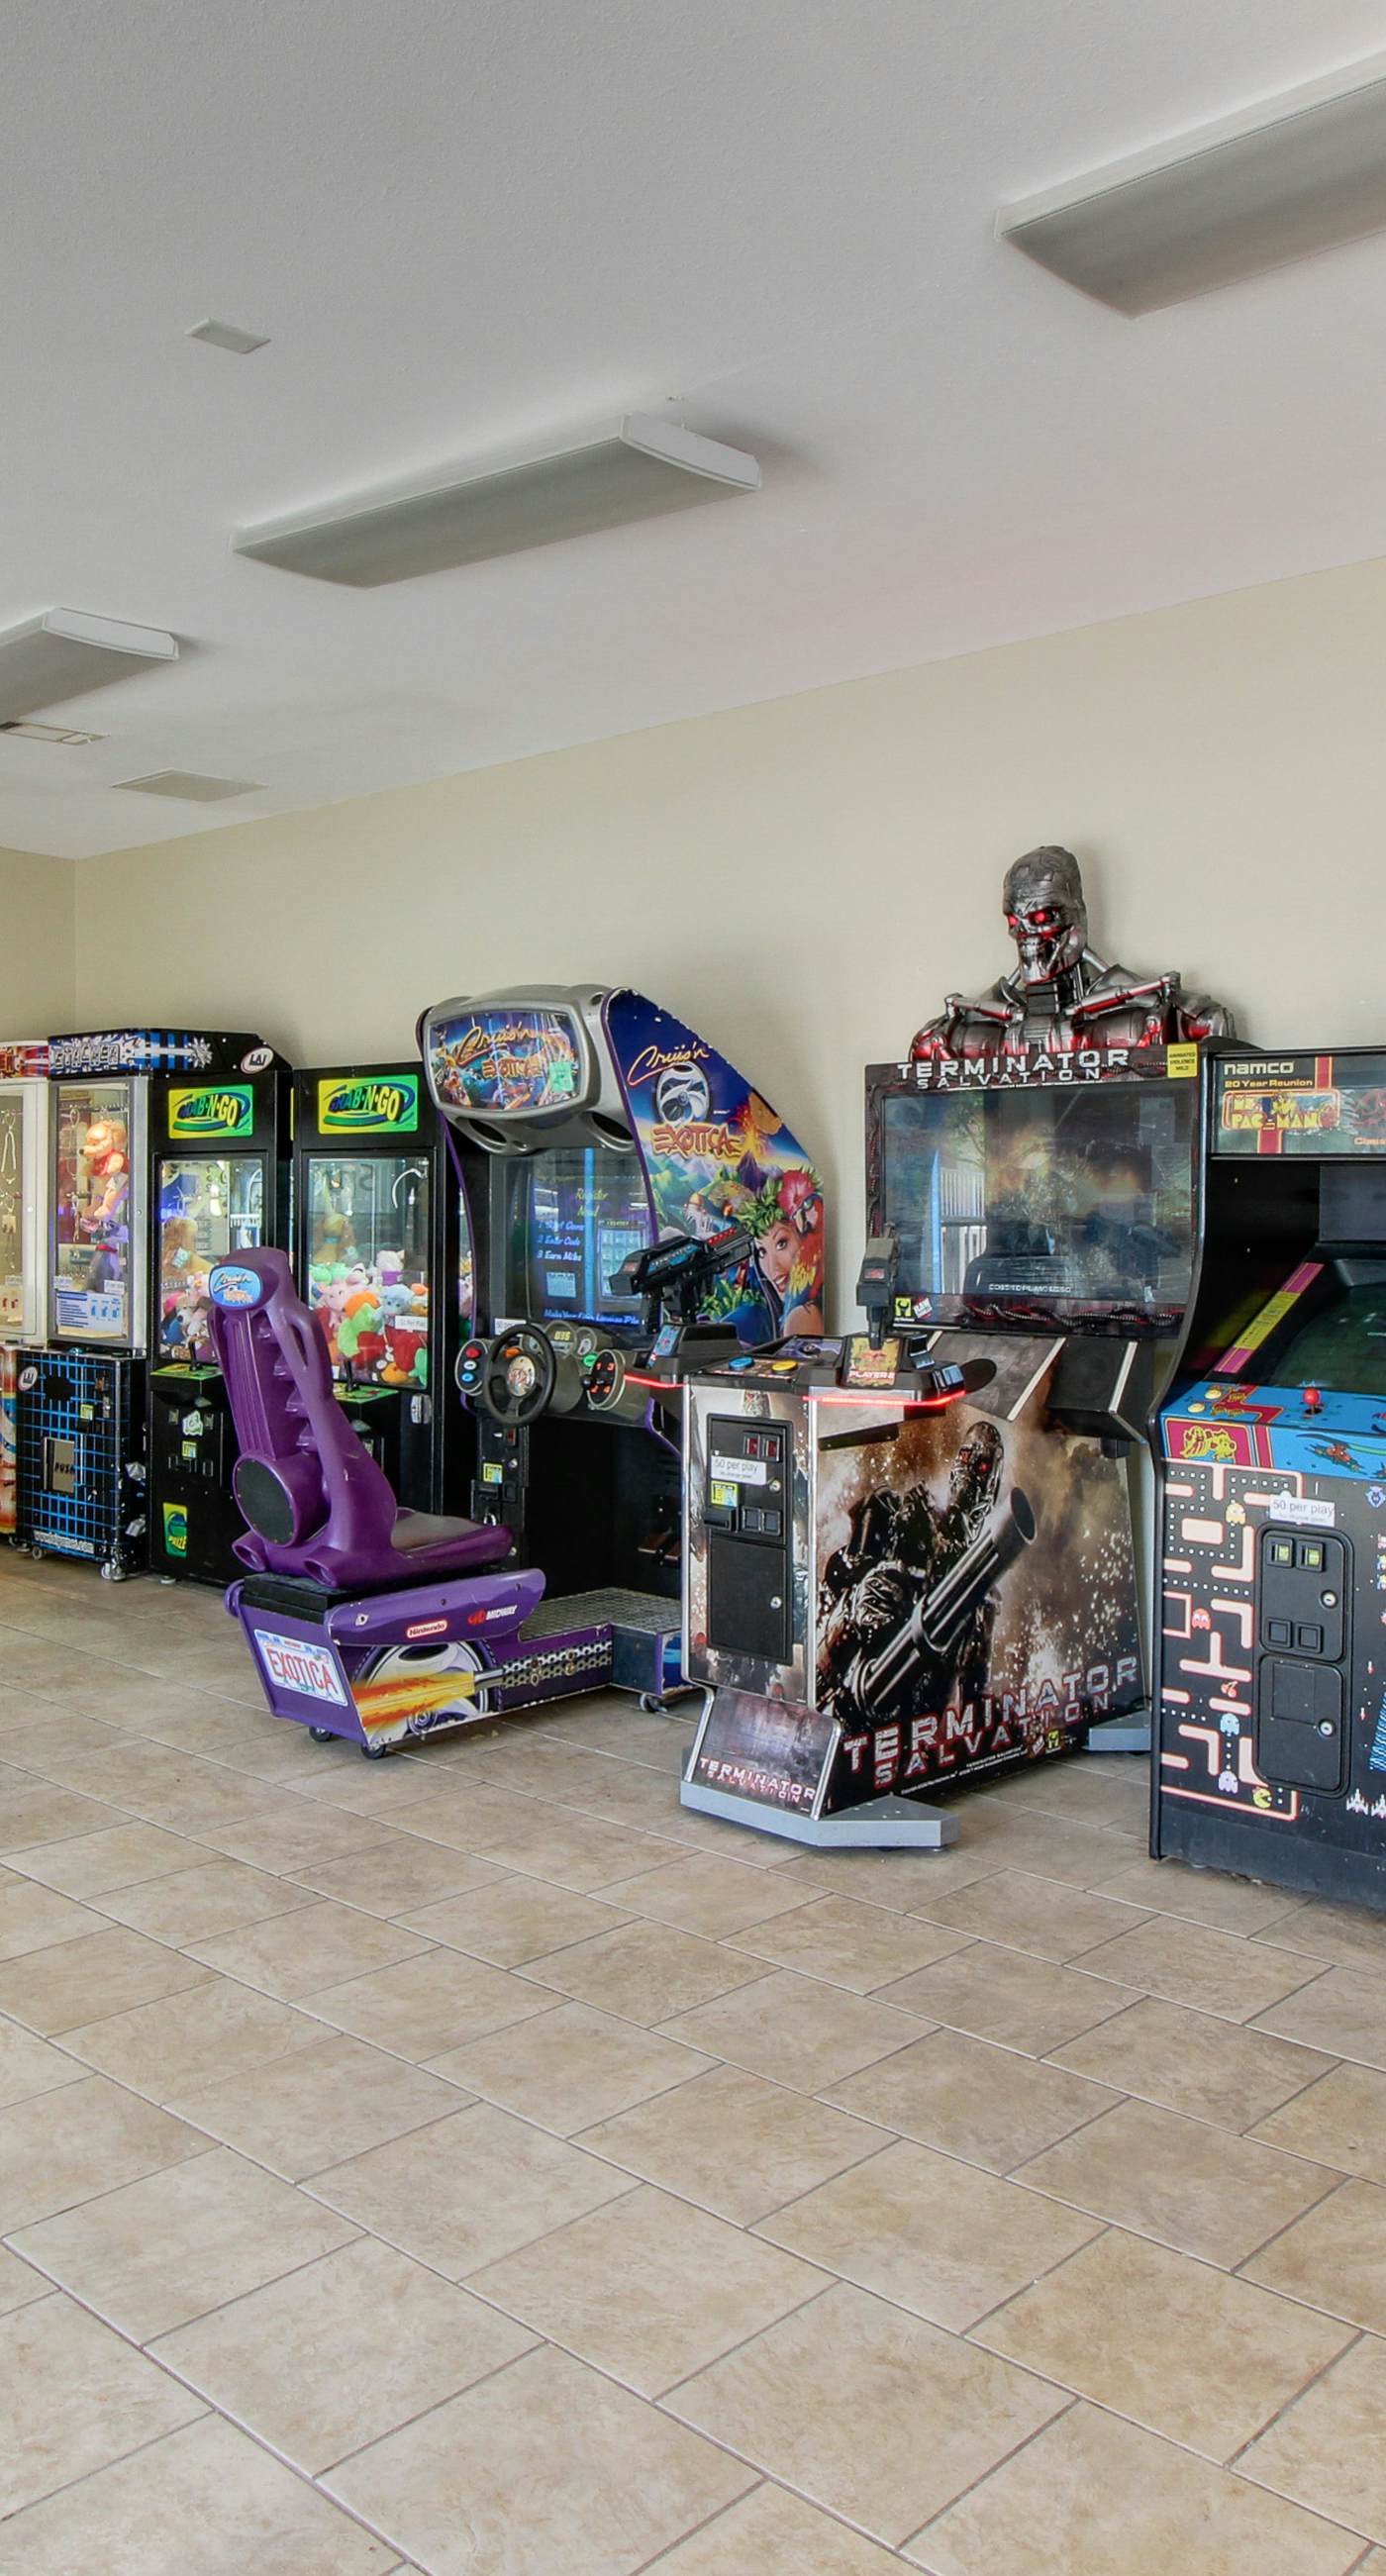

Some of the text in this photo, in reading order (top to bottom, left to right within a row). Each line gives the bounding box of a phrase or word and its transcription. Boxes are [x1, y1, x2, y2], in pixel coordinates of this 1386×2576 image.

[456, 1021, 536, 1067] Cruis'n
[627, 1040, 711, 1086] Cruis'n
[896, 1049, 1130, 1079] TERMINATOR
[1224, 1061, 1295, 1076] namco
[917, 1067, 1101, 1089] SALVATION
[1224, 1078, 1314, 1088] 20 Year Reunion
[1231, 1112, 1320, 1130] PAC-MAN
[651, 1123, 742, 1158] EXOTICA
[848, 1370, 888, 1379] PLAYER
[727, 1460, 741, 1471] per
[742, 1461, 758, 1474] play
[1272, 1499, 1334, 1517] 50 per play
[485, 1604, 519, 1621] MIDWAY
[408, 1622, 446, 1636] Nintendo
[265, 1646, 339, 1695] EXOTICA
[842, 1655, 1138, 1773] TERMINATOR
[873, 1692, 1110, 1789] SALVATION
[699, 1756, 817, 1801] TERMINATOR
[706, 1769, 801, 1804] SALVATION
